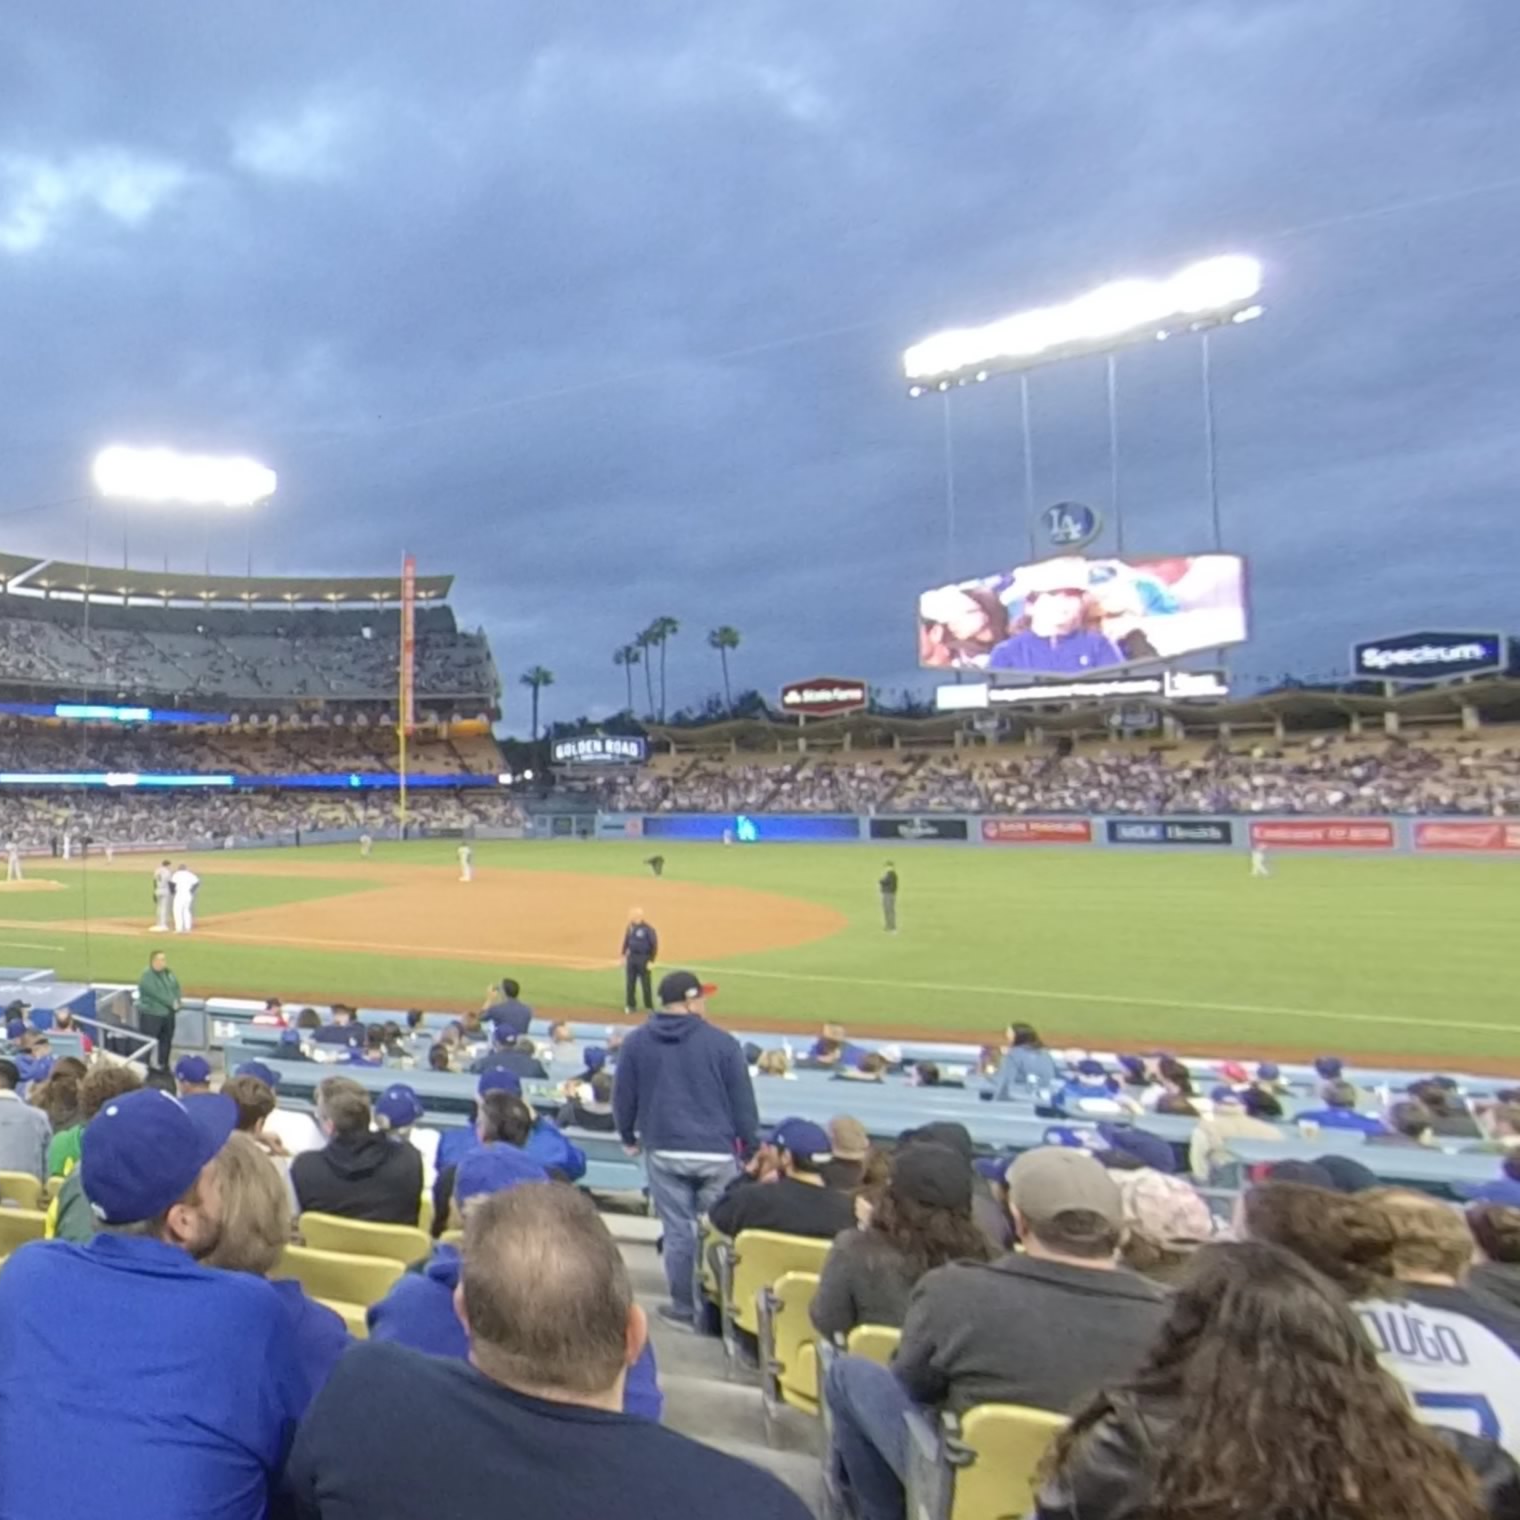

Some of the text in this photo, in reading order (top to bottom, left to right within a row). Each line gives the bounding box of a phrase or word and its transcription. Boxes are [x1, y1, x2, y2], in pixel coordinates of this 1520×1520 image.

[1049, 509, 1082, 541] LA
[1361, 644, 1485, 669] Spectrum
[555, 739, 602, 760] GOLDEN
[605, 739, 638, 757] ROAD
